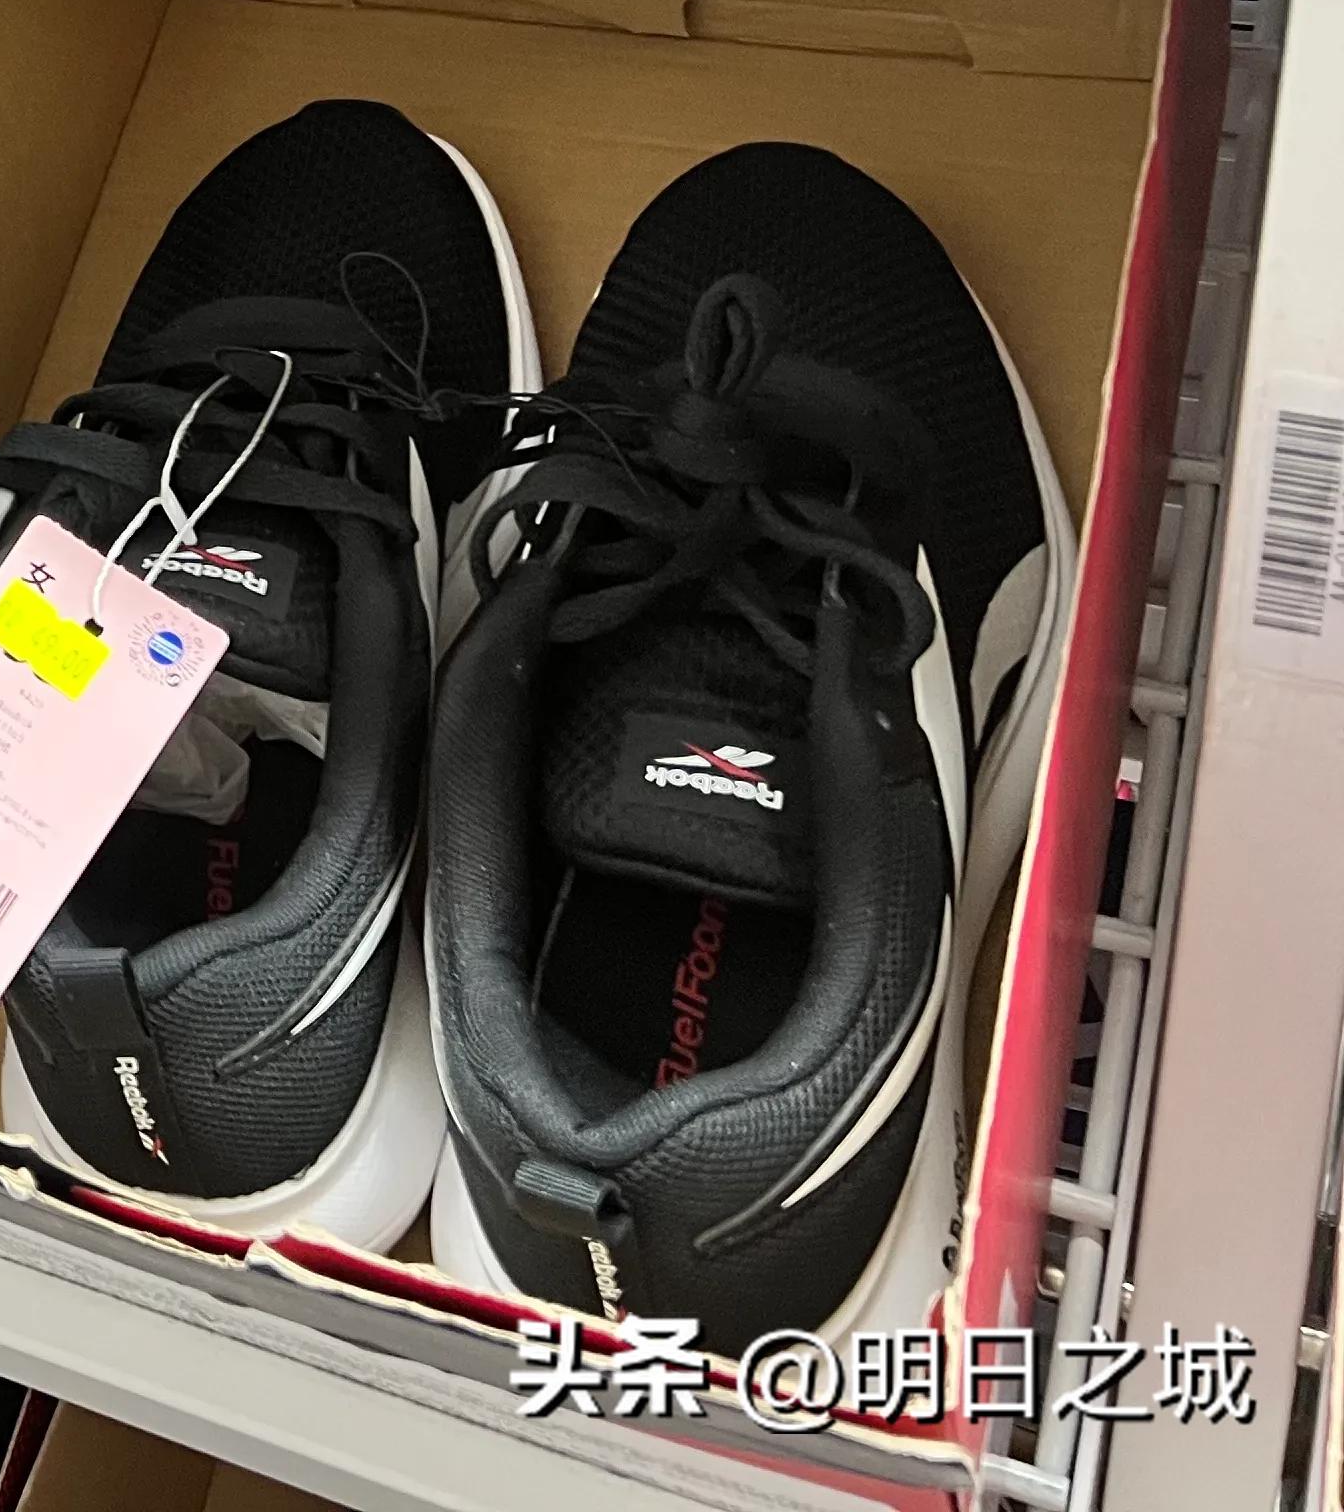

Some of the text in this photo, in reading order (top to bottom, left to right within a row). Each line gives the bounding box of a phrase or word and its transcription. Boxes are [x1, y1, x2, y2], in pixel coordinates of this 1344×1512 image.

[19, 561, 56, 594] 女
[644, 764, 784, 811] Reebok
[207, 838, 240, 921] Fue
[581, 1236, 624, 1302] eebok
